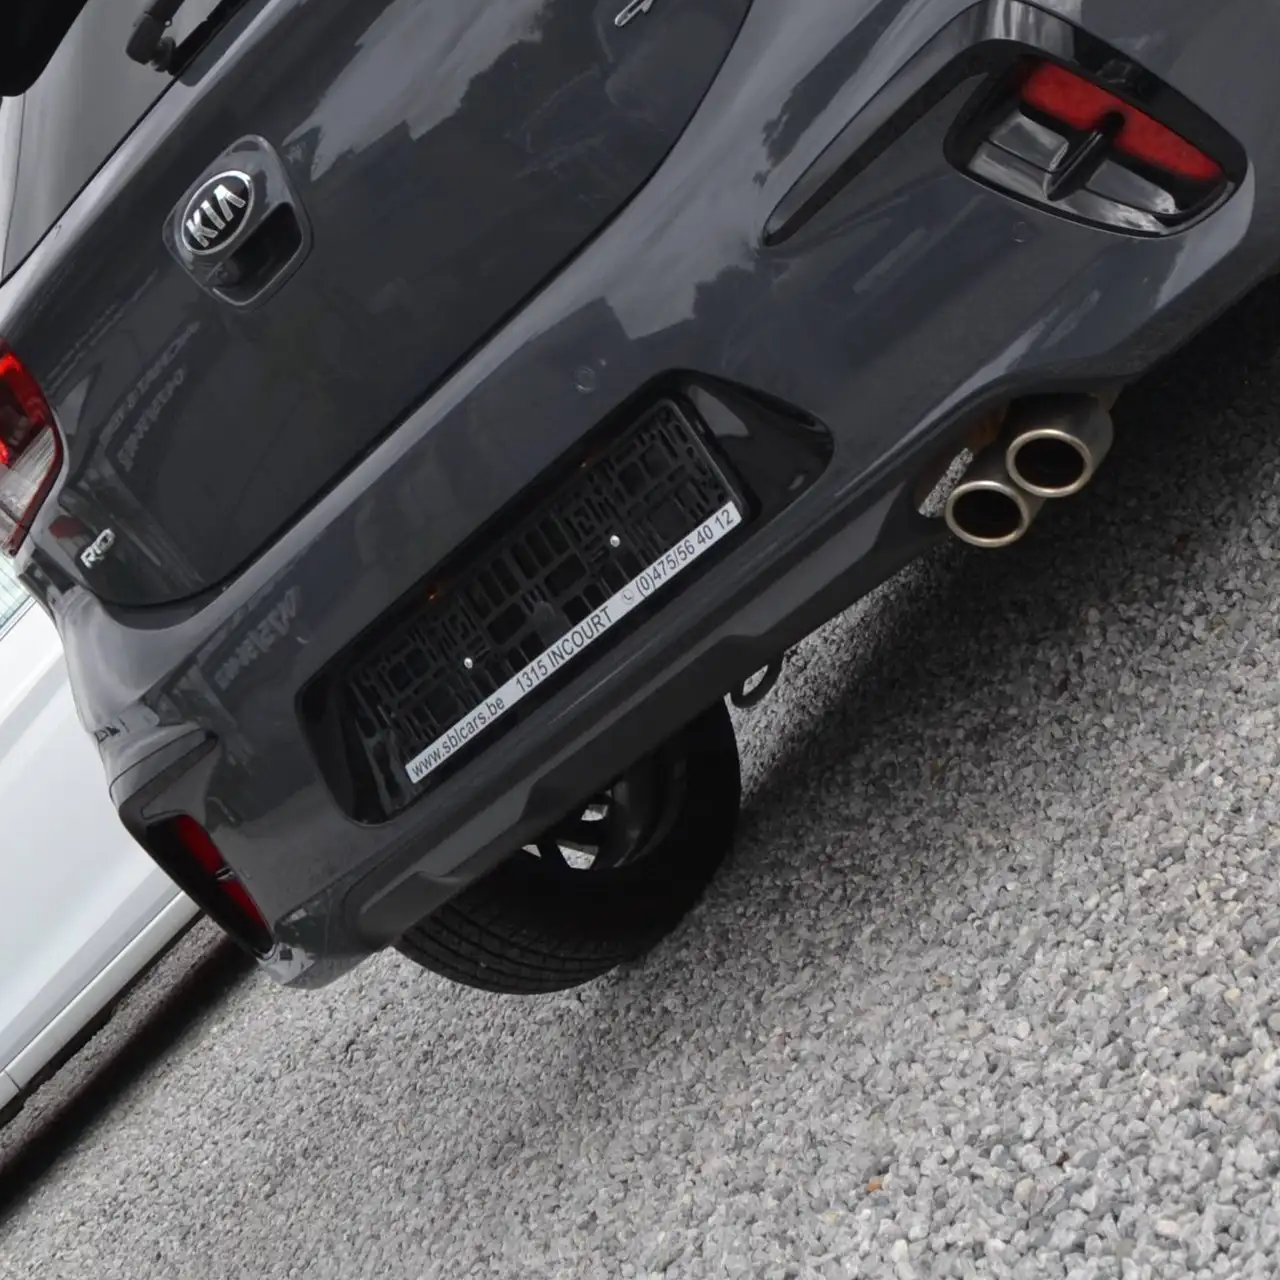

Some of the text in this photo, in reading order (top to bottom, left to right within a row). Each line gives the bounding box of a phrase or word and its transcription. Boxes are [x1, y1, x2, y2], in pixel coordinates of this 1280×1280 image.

[185, 184, 246, 248] KIA
[80, 527, 116, 569] RIO
[411, 509, 734, 778] www.sblcars.be 1315 INCOURT (0)475/56 40 12
